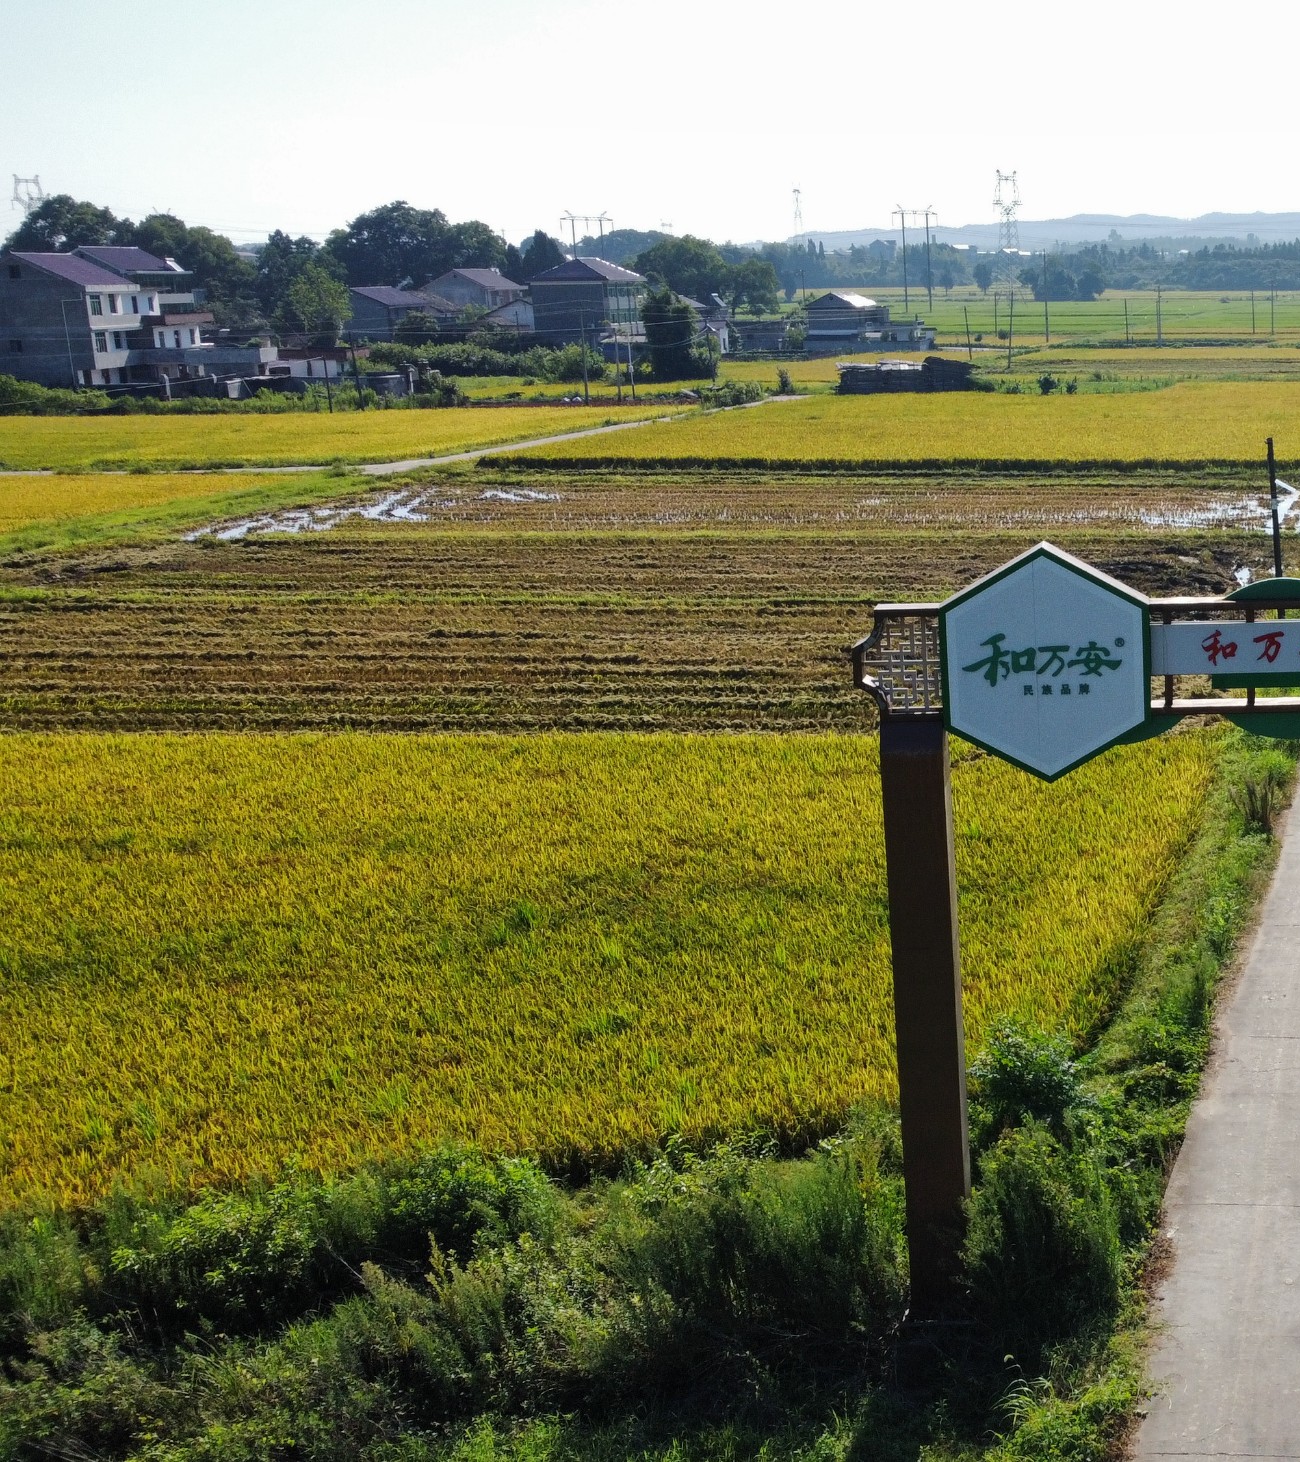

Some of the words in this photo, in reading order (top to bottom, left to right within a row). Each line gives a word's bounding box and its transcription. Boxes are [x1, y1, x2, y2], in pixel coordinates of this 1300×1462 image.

[962, 633, 1122, 687] 和万安
[1023, 684, 1090, 696] 民族品牌
